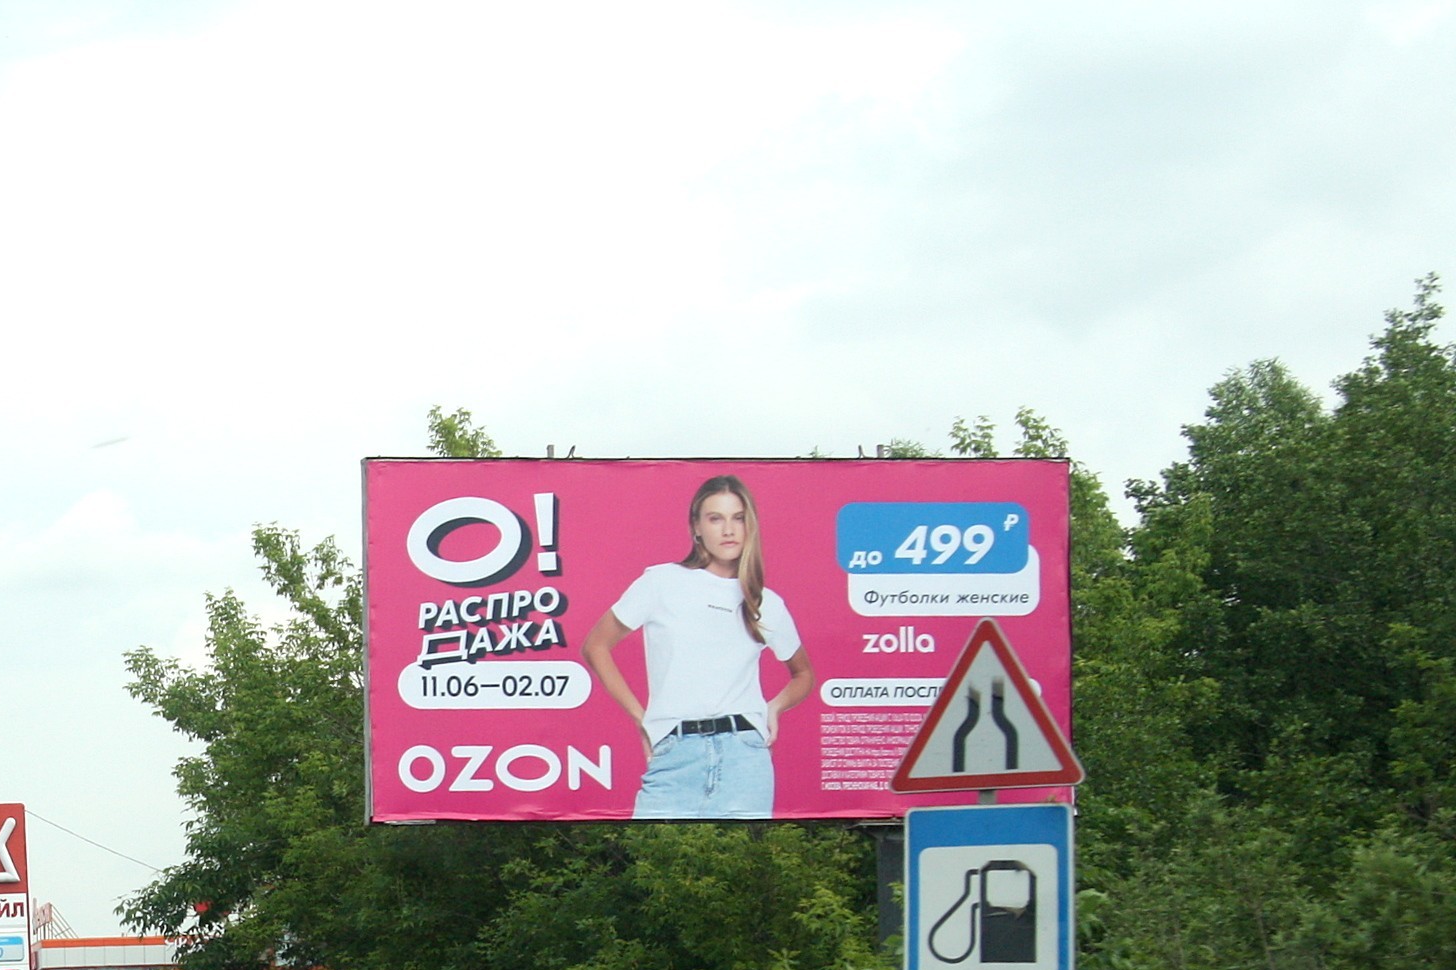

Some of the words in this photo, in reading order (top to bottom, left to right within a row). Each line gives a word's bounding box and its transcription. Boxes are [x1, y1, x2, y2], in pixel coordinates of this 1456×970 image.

[848, 551, 883, 569] до
[895, 524, 995, 565] 499
[418, 586, 561, 629] РАСПРО
[863, 590, 949, 607] Футболки
[956, 592, 1030, 604] женские
[417, 619, 560, 665] ДАЖА
[862, 626, 935, 653] zolla
[830, 686, 889, 698] ОПЛАТА
[398, 744, 612, 793] OZON
